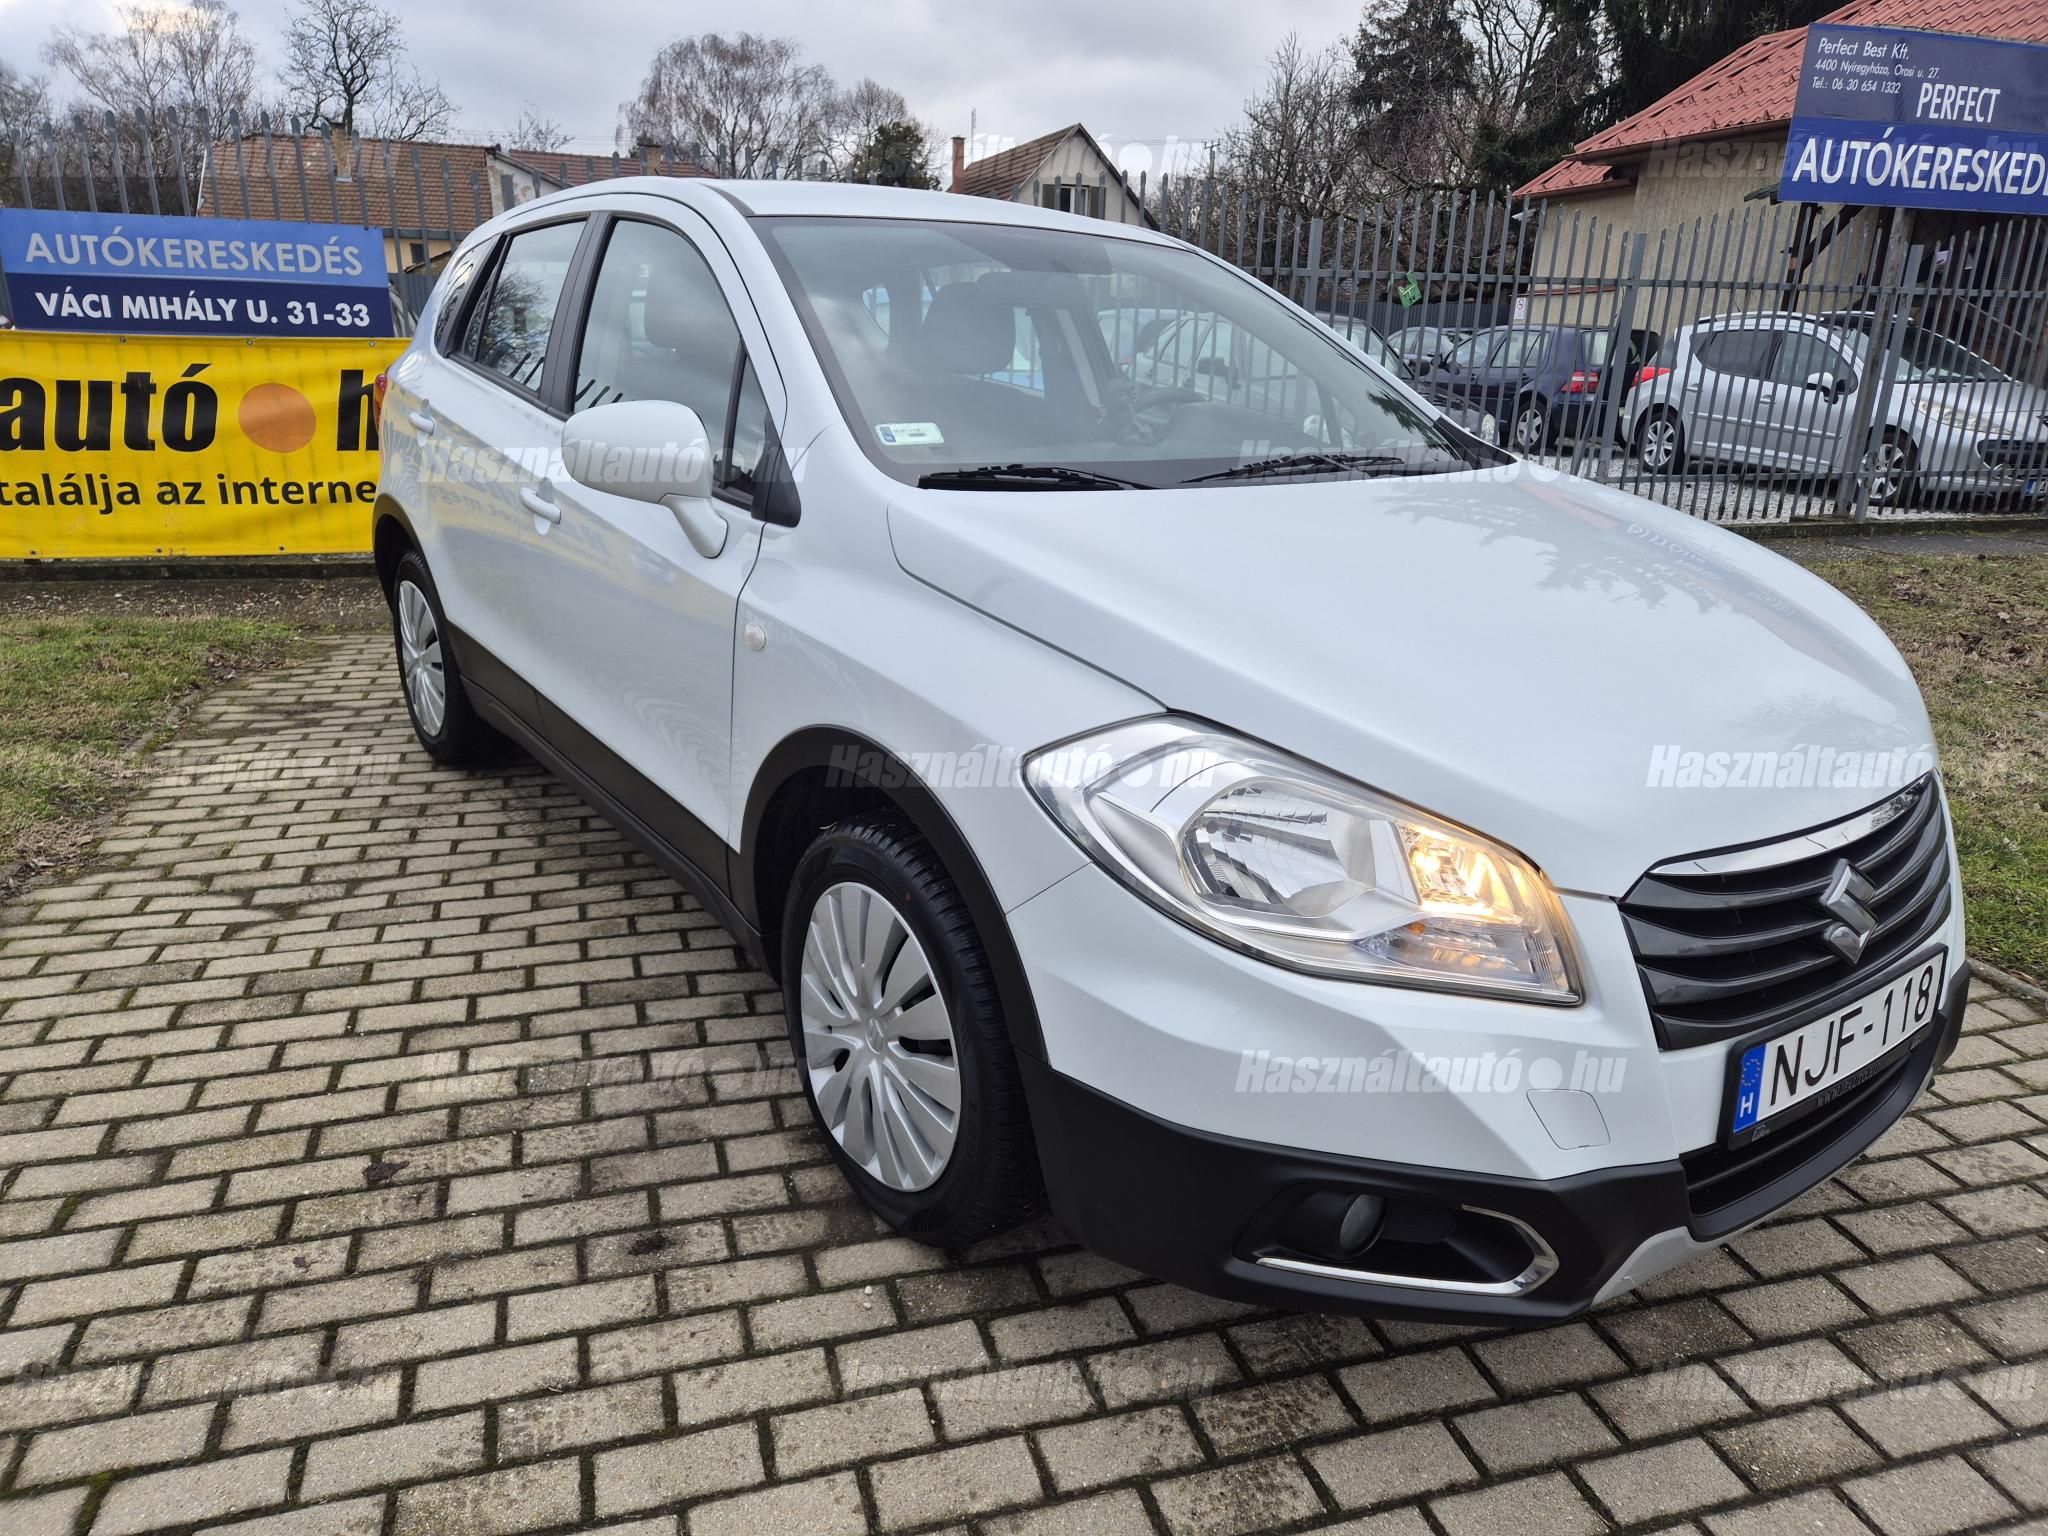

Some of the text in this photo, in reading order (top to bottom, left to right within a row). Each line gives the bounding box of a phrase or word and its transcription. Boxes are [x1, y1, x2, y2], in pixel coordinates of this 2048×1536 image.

[1817, 37, 1910, 60] Perfect Best Kft.
[1812, 76, 1901, 94] Tel.: 06 30 654 1332
[1814, 59, 1838, 72] 4400
[1839, 60, 1891, 77] Nyíregyháza,
[1916, 82, 2001, 124] PERFECT
[1791, 127, 2048, 197] AUTÓKERESKED
[25, 225, 364, 277] AUTÓKERESKEDÉS
[35, 286, 371, 328] VÁCI MIHÁLY U. 31-33
[156, 480, 206, 506] az
[1769, 964, 1935, 1107] NJF-118
[1739, 1092, 1755, 1119] H
